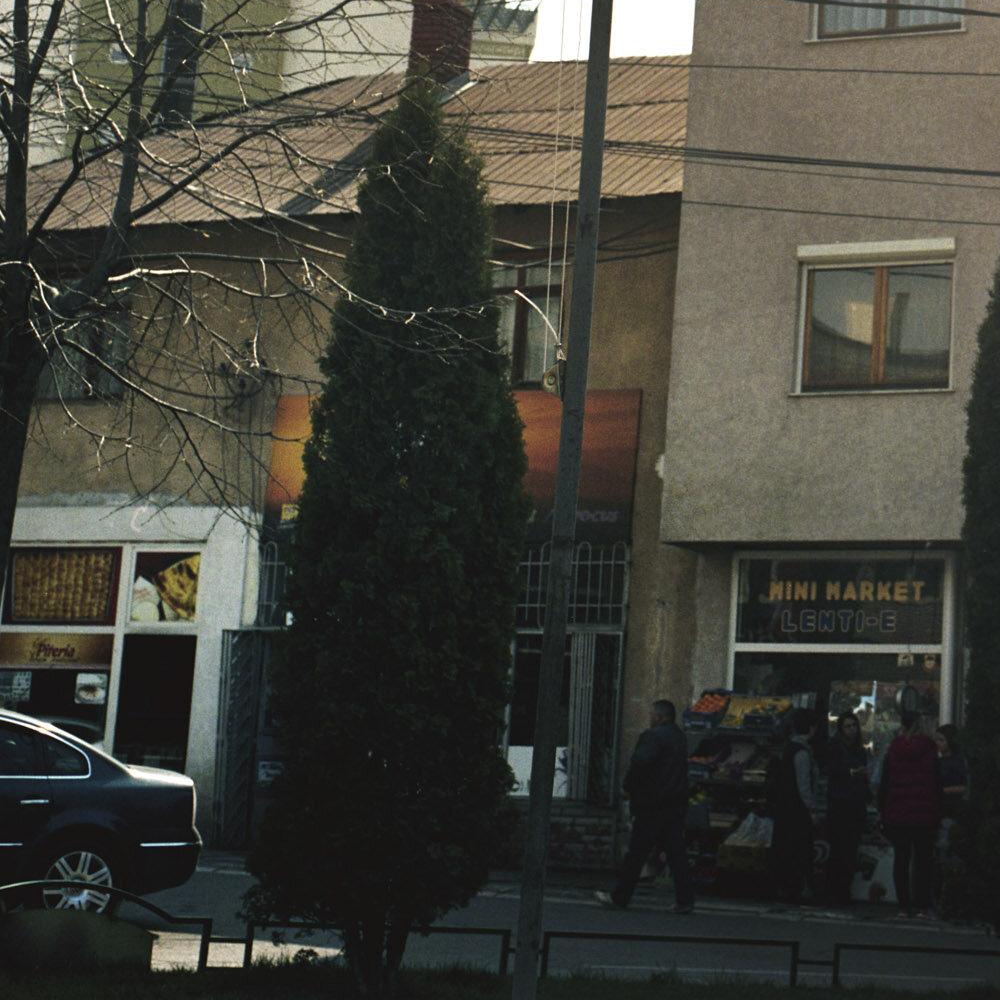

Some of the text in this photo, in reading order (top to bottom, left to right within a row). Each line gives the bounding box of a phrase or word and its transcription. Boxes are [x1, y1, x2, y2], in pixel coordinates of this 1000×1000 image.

[769, 581, 925, 602] MINI MARKET
[781, 609, 897, 632] LENTI-E
[37, 643, 75, 658] Piteria
